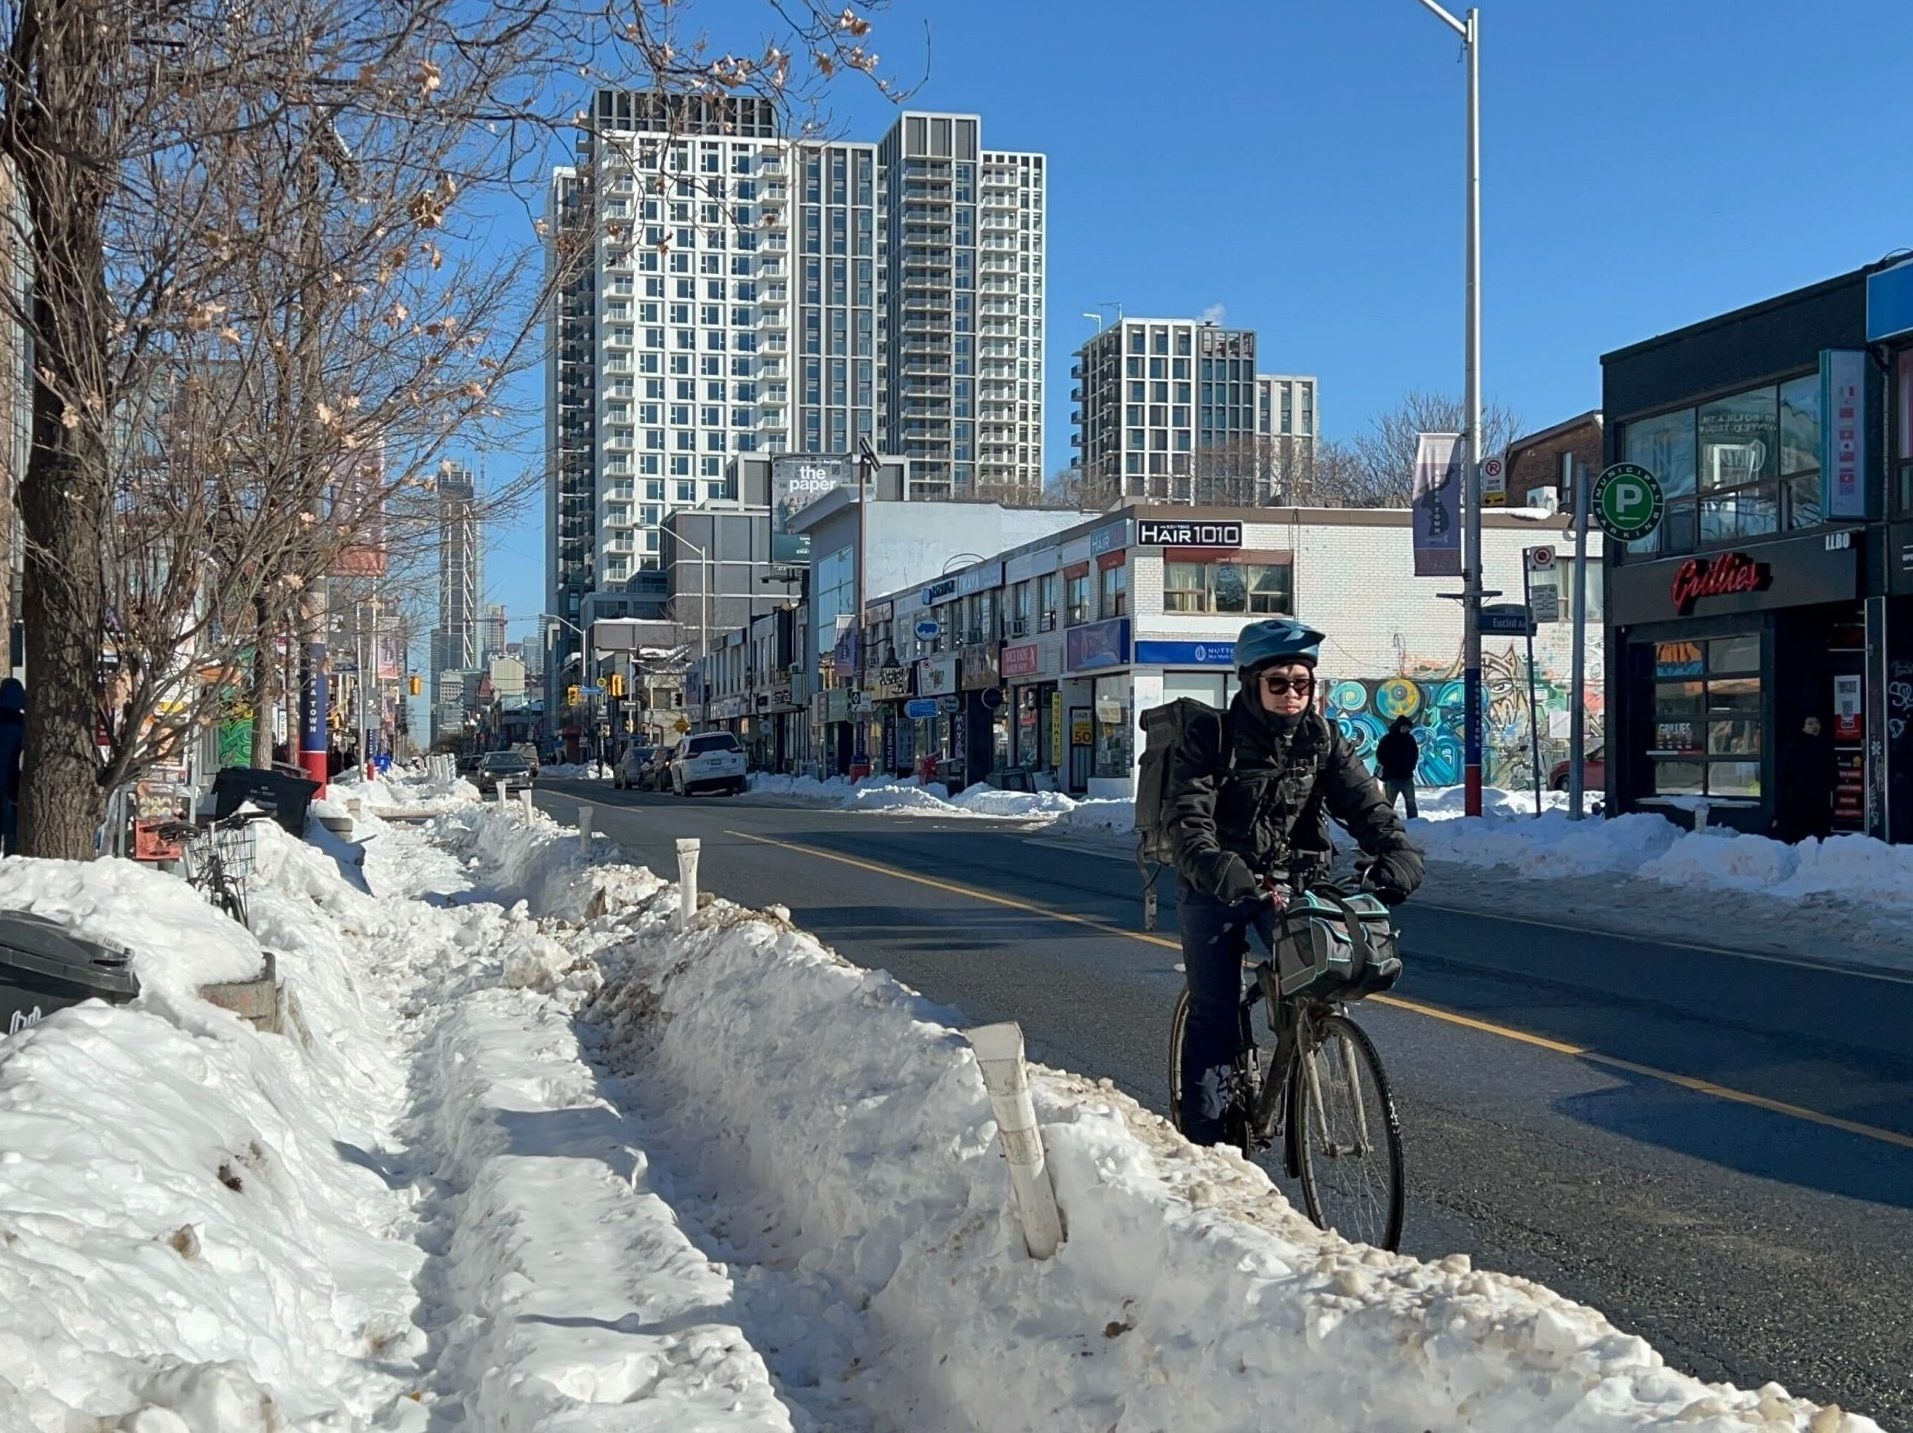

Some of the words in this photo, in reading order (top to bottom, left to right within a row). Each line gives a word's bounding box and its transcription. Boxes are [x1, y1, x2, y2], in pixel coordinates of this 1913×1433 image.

[800, 466, 826, 480] the
[789, 479, 837, 493] paper
[1595, 467, 1661, 501] MUNICIPAL
[1595, 507, 1661, 538] PARKING
[1141, 525, 1192, 543] HAIR
[1193, 526, 1239, 543] 1010
[1825, 533, 1850, 551] LLBO
[1671, 553, 1760, 606] Grillies
[1493, 617, 1517, 628] Euclid
[1074, 731, 1092, 742] 50
